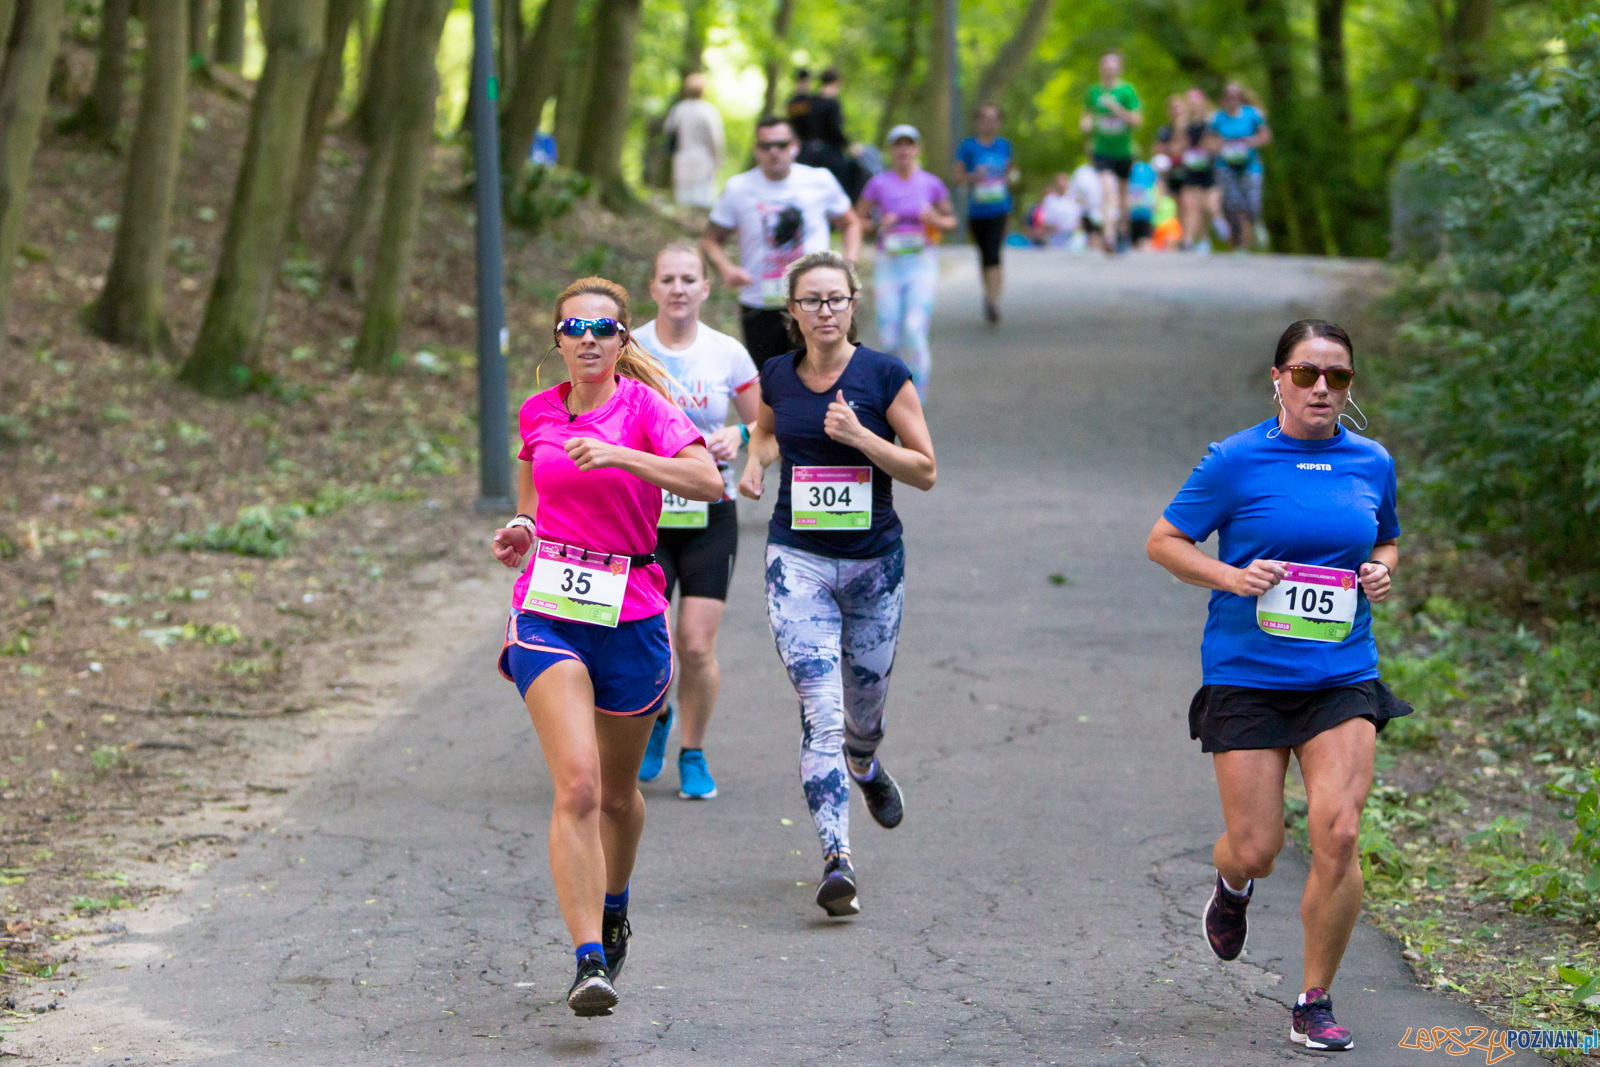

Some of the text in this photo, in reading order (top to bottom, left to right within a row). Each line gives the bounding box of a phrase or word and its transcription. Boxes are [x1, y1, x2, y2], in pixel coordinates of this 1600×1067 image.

[809, 486, 852, 507] 304
[561, 568, 593, 595] 35
[1285, 586, 1335, 615] 105
